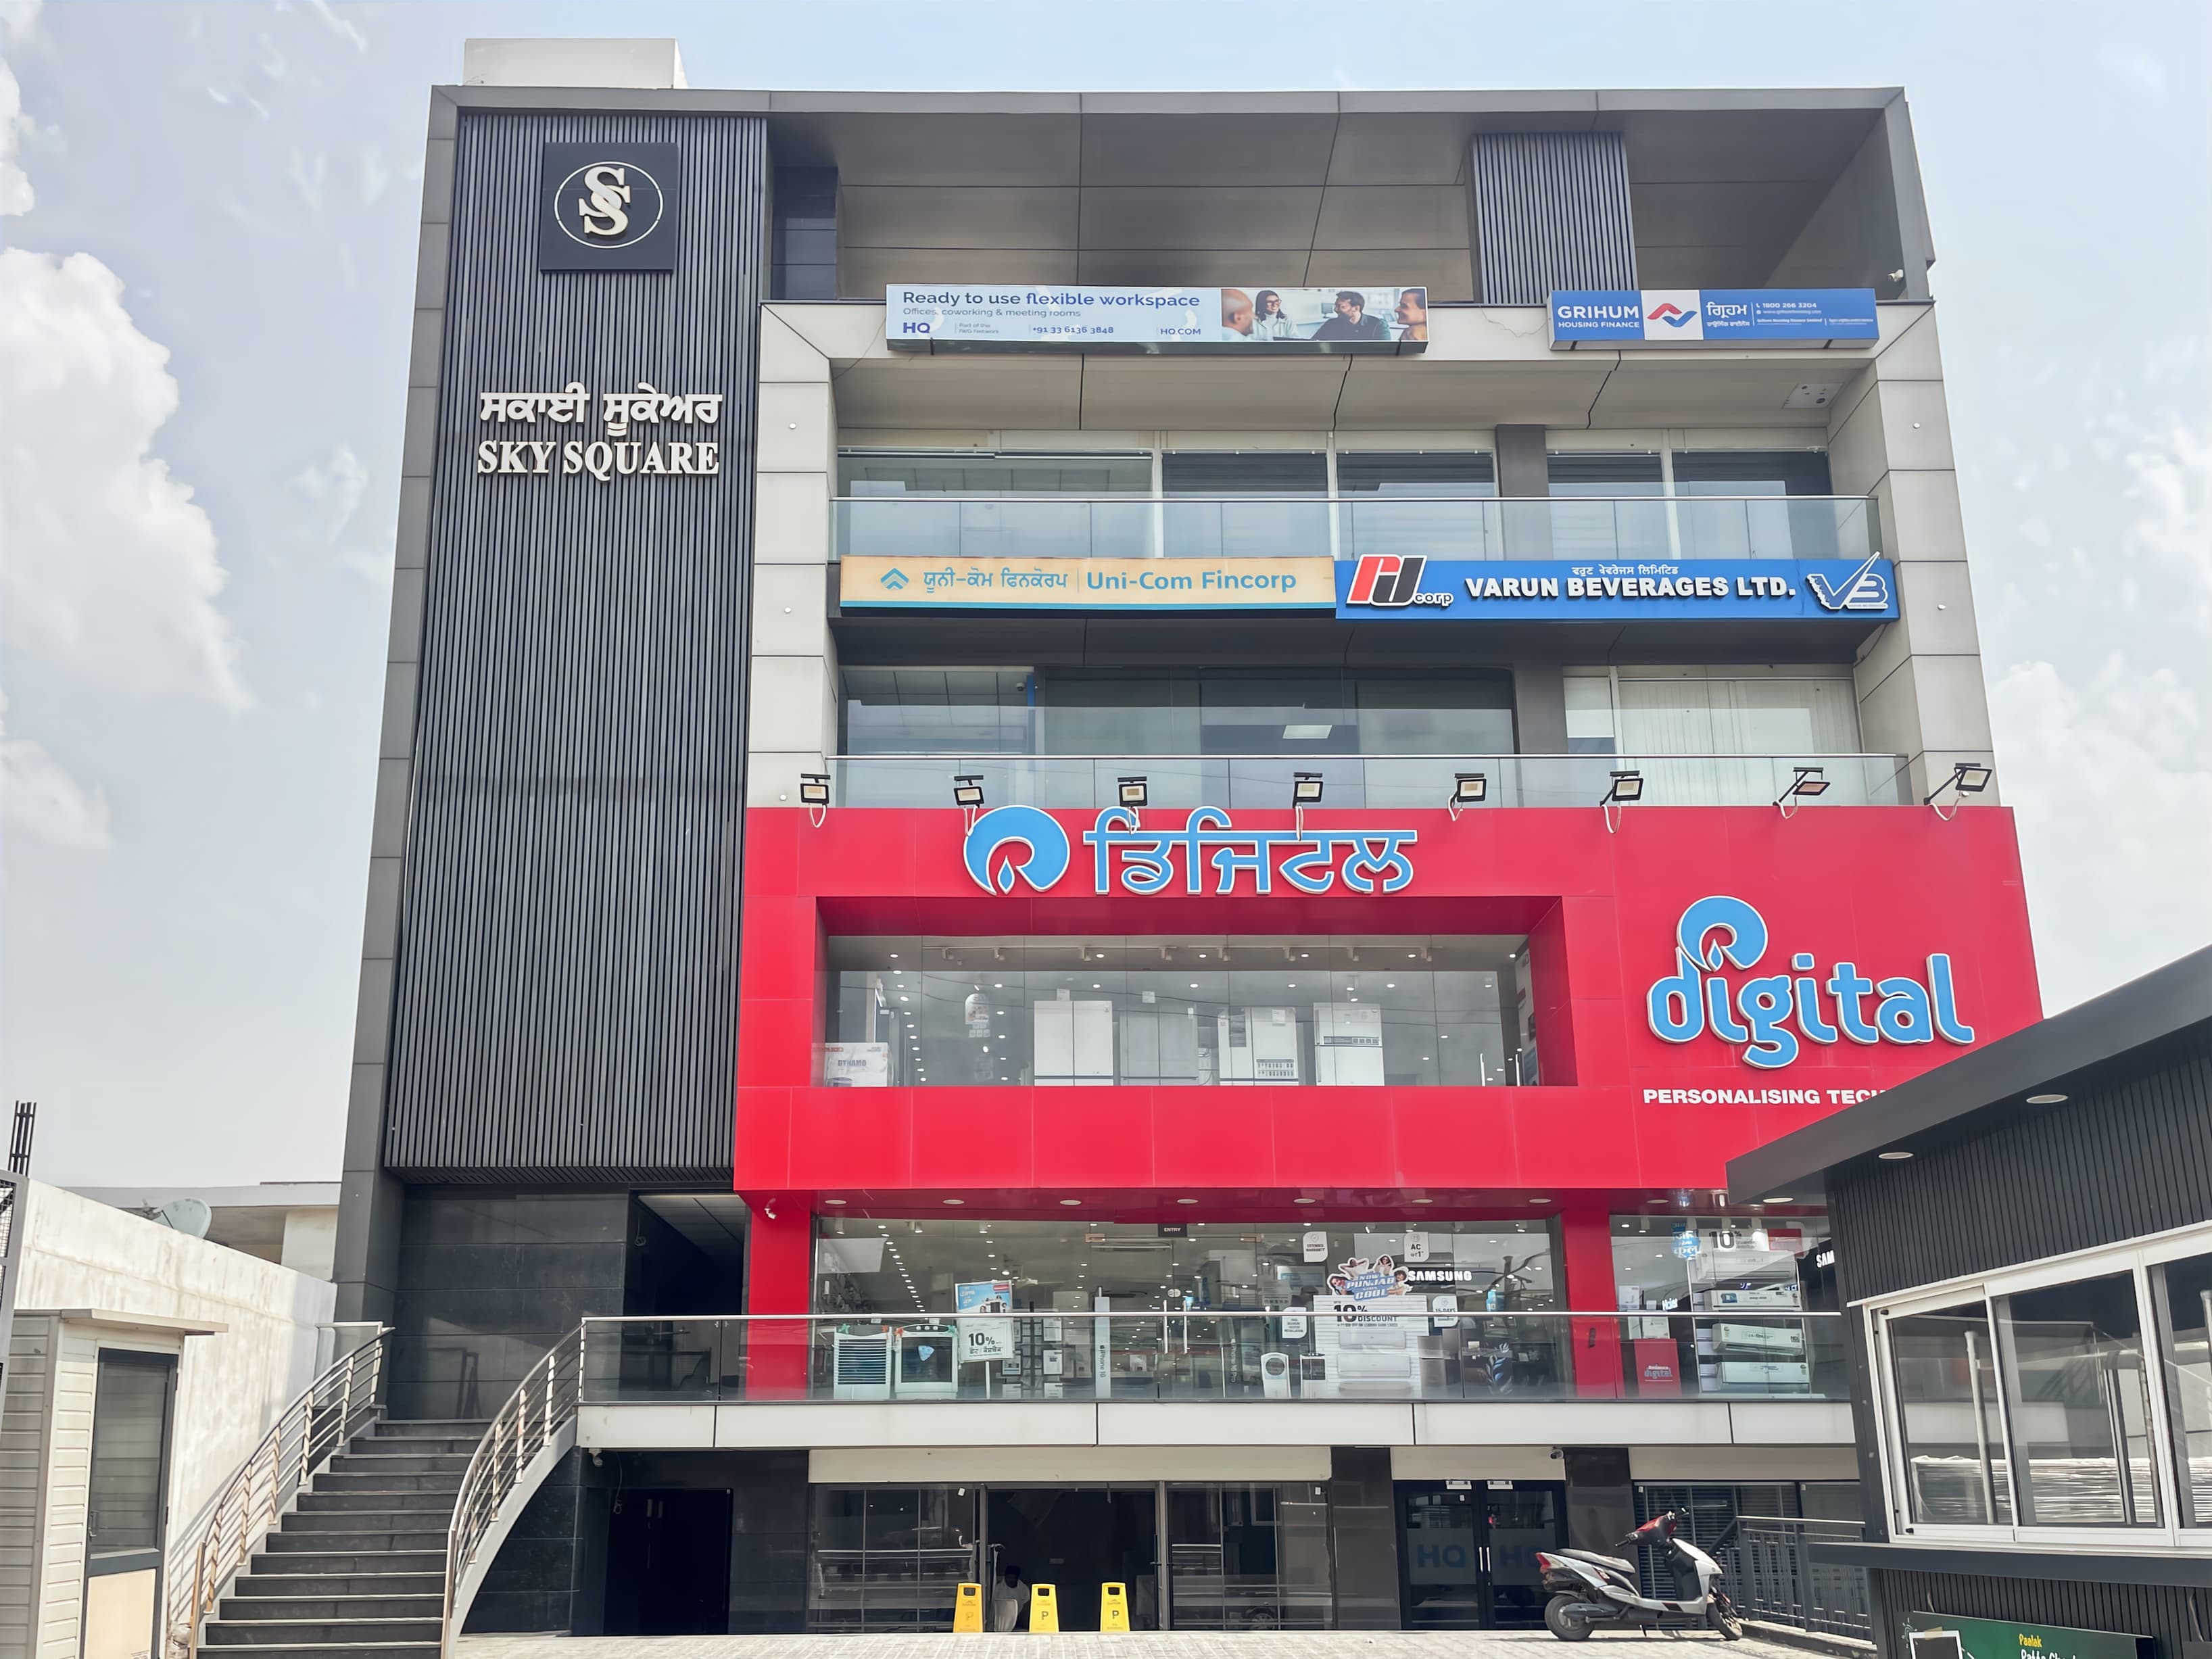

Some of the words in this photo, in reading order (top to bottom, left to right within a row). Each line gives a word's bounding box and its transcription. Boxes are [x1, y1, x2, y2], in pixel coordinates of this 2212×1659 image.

[903, 292, 960, 306] Ready
[966, 293, 983, 304] to
[989, 295, 1021, 304] use
[1026, 293, 1095, 306] flexible
[1099, 294, 1200, 308] workspace
[942, 308, 993, 318] coworking
[996, 308, 1003, 316] &
[1006, 309, 1047, 318] meeting
[1558, 306, 1639, 319] GRIHUM
[903, 322, 931, 334] HQ
[480, 382, 590, 423] ਸਕਾਈ
[477, 440, 556, 475] SKY
[563, 440, 719, 482] SQUARE
[1087, 572, 1193, 590] Uni-Com
[1201, 570, 1297, 592] Fincorp
[1466, 577, 1559, 597] VARUN
[1567, 577, 1729, 598] BEVERAGES
[1737, 579, 1796, 596] LTD.
[1413, 592, 1454, 607] corp
[1082, 805, 1418, 895] ਡਿਜਿਟਲ
[1647, 946, 1975, 1069] digital
[1643, 1088, 1820, 1105] PERSONALISING
[1408, 1271, 1472, 1282] SAMSUNG
[968, 1332, 996, 1347] 10%
[1417, 1544, 1466, 1568] HQ
[1042, 1612, 1049, 1620] P
[1112, 1610, 1120, 1619] P
[2019, 1633, 2042, 1648] Paalak
